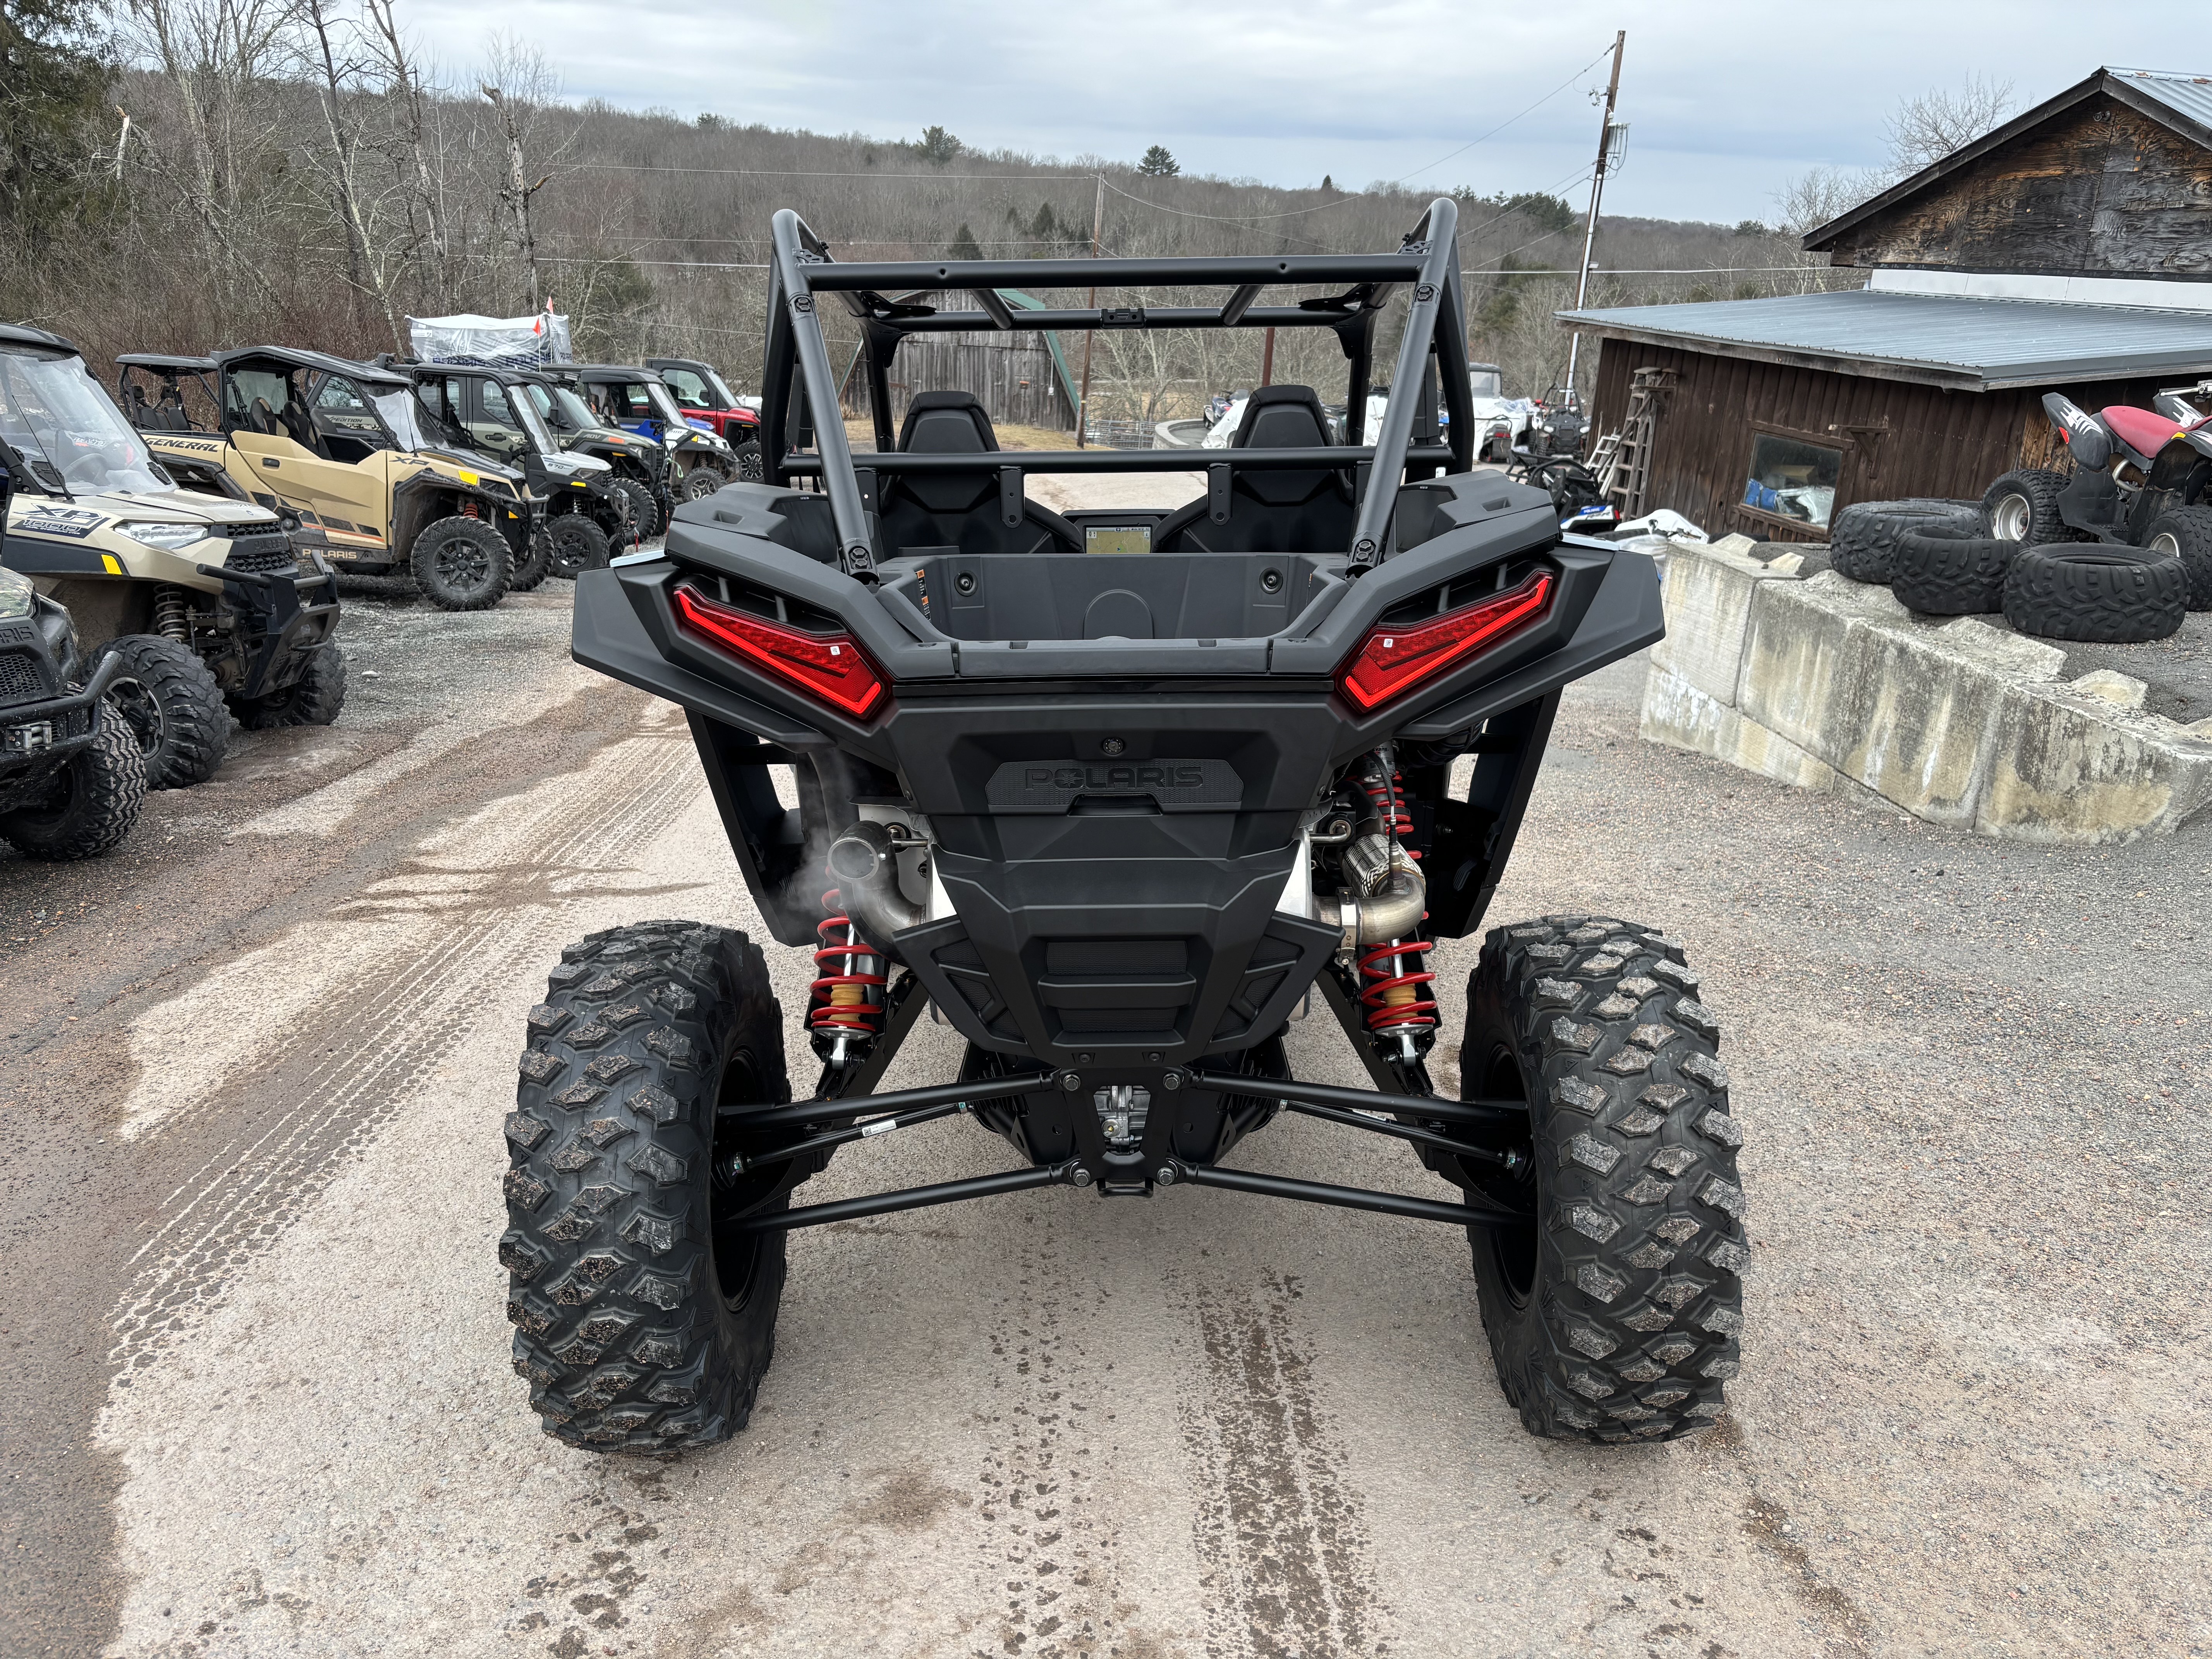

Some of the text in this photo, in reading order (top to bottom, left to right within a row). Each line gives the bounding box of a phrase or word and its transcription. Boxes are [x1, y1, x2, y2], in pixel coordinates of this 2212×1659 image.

[145, 438, 219, 452] GENERAL
[388, 456, 430, 466] XP
[13, 503, 102, 520] XP
[22, 519, 81, 532] 1000
[302, 548, 357, 559] PLARIS
[0, 626, 35, 644] RIS
[1025, 767, 1203, 790] POLARIS
